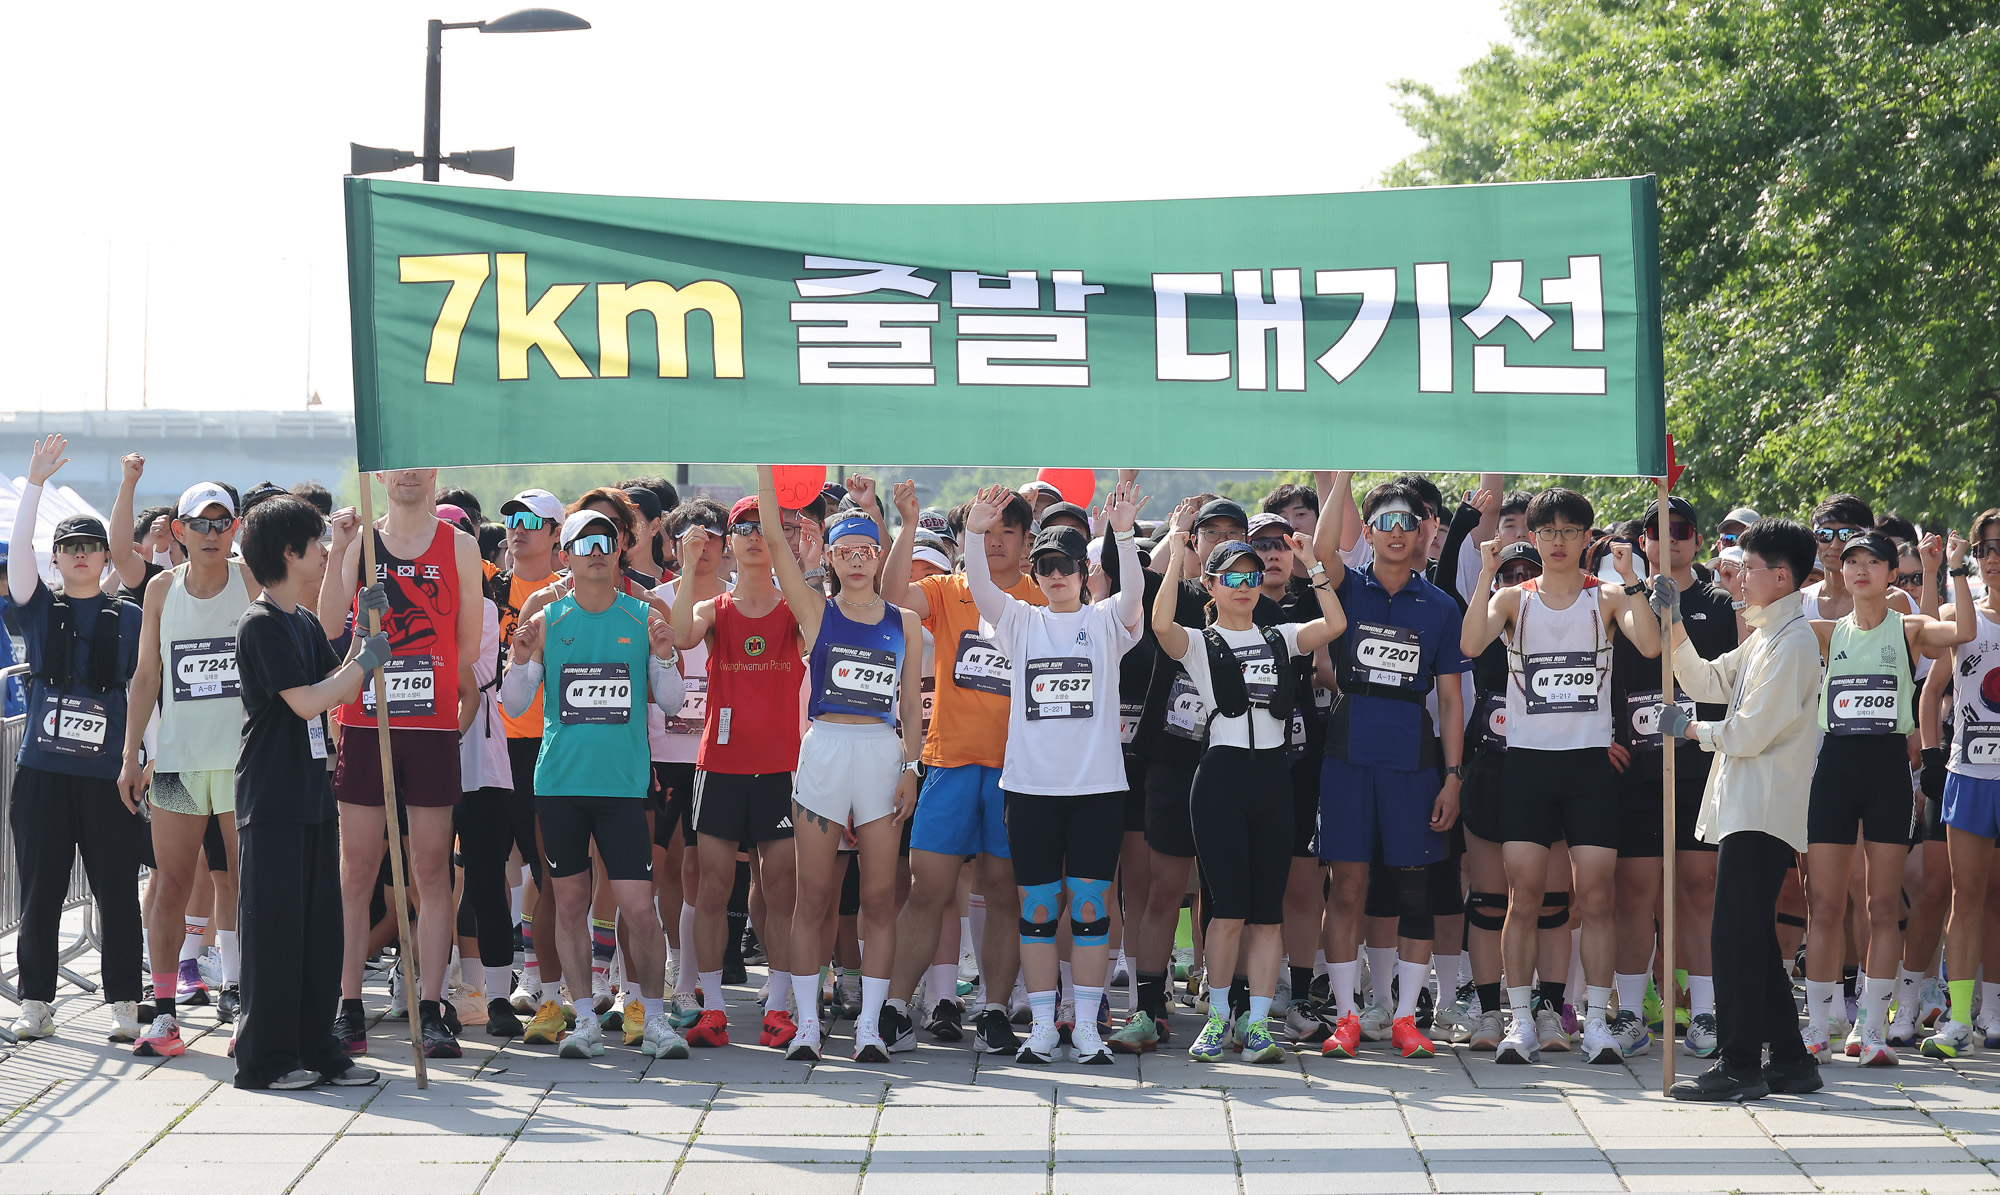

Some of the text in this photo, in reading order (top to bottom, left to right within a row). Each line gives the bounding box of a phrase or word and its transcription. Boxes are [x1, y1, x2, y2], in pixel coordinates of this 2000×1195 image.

[398, 251, 1608, 396] 7km 출발 대기선
[422, 564, 441, 580] 포
[1363, 646, 1418, 663] M 7207
[184, 658, 238, 673] M 7247
[770, 660, 791, 672] Pacing
[969, 653, 1013, 670] M 720
[963, 665, 983, 673] A-72
[1251, 664, 1279, 674] 768
[838, 668, 894, 685] W 7914
[1376, 673, 1396, 682] A-19
[1538, 673, 1594, 686] M 7309
[198, 684, 217, 692] A-87
[391, 677, 432, 690] 7160
[1036, 679, 1091, 692] W 7637
[573, 685, 629, 697] M 7110
[1315, 688, 1324, 698] M
[1180, 700, 1191, 710] M
[1839, 695, 1895, 708] W 7808
[63, 716, 104, 733] 7797
[1496, 715, 1505, 724] W
[1639, 715, 1648, 724] M
[1973, 745, 1983, 755] M
